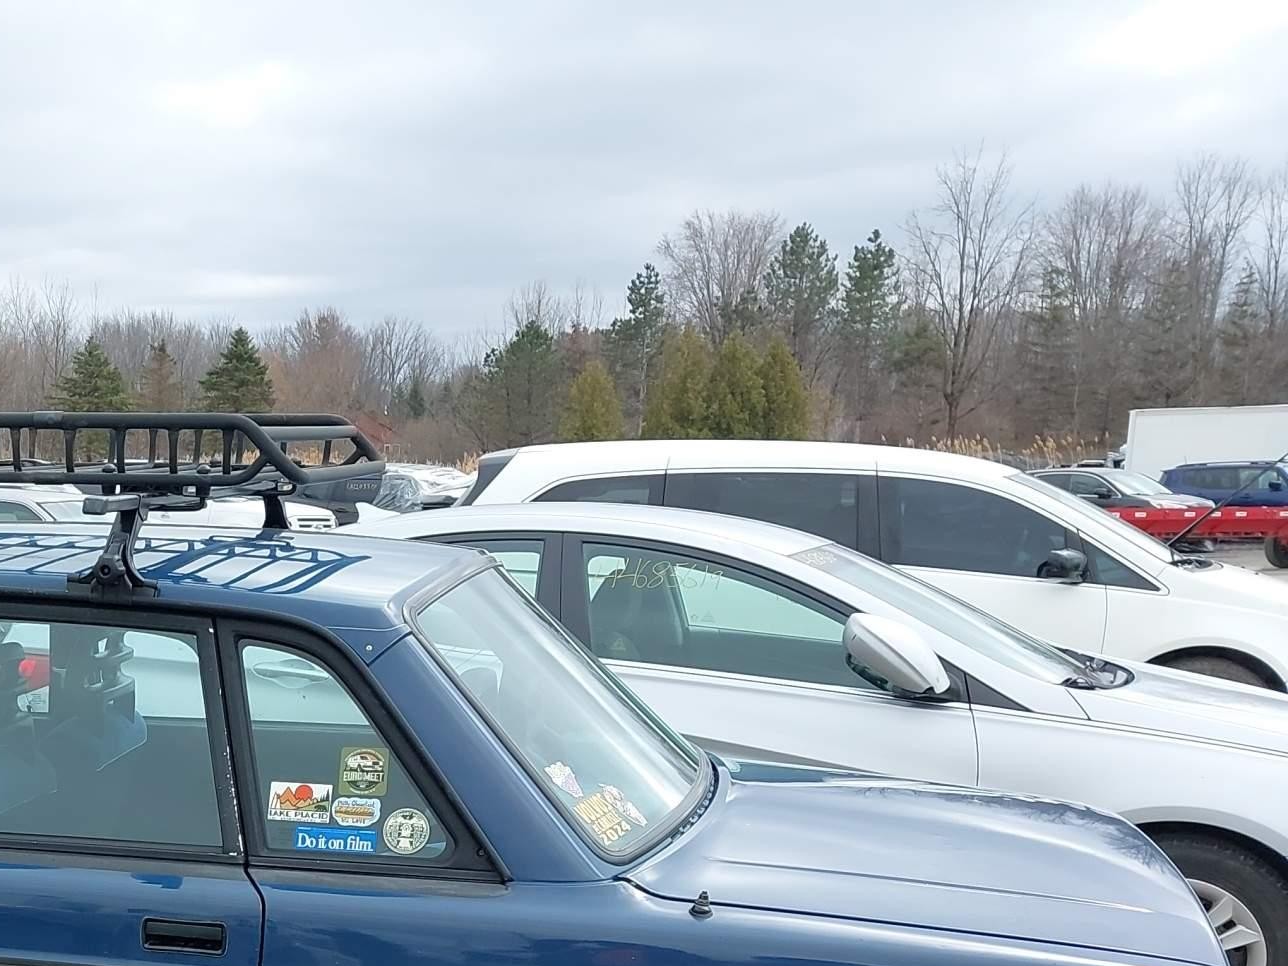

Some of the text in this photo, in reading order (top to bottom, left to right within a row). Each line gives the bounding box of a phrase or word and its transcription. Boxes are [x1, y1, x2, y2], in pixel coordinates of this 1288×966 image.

[270, 810, 292, 818] LAKE
[295, 812, 329, 820] PLACID
[298, 833, 318, 849] Do
[318, 835, 328, 849] it
[329, 839, 345, 850] on
[598, 821, 632, 847] 2024
